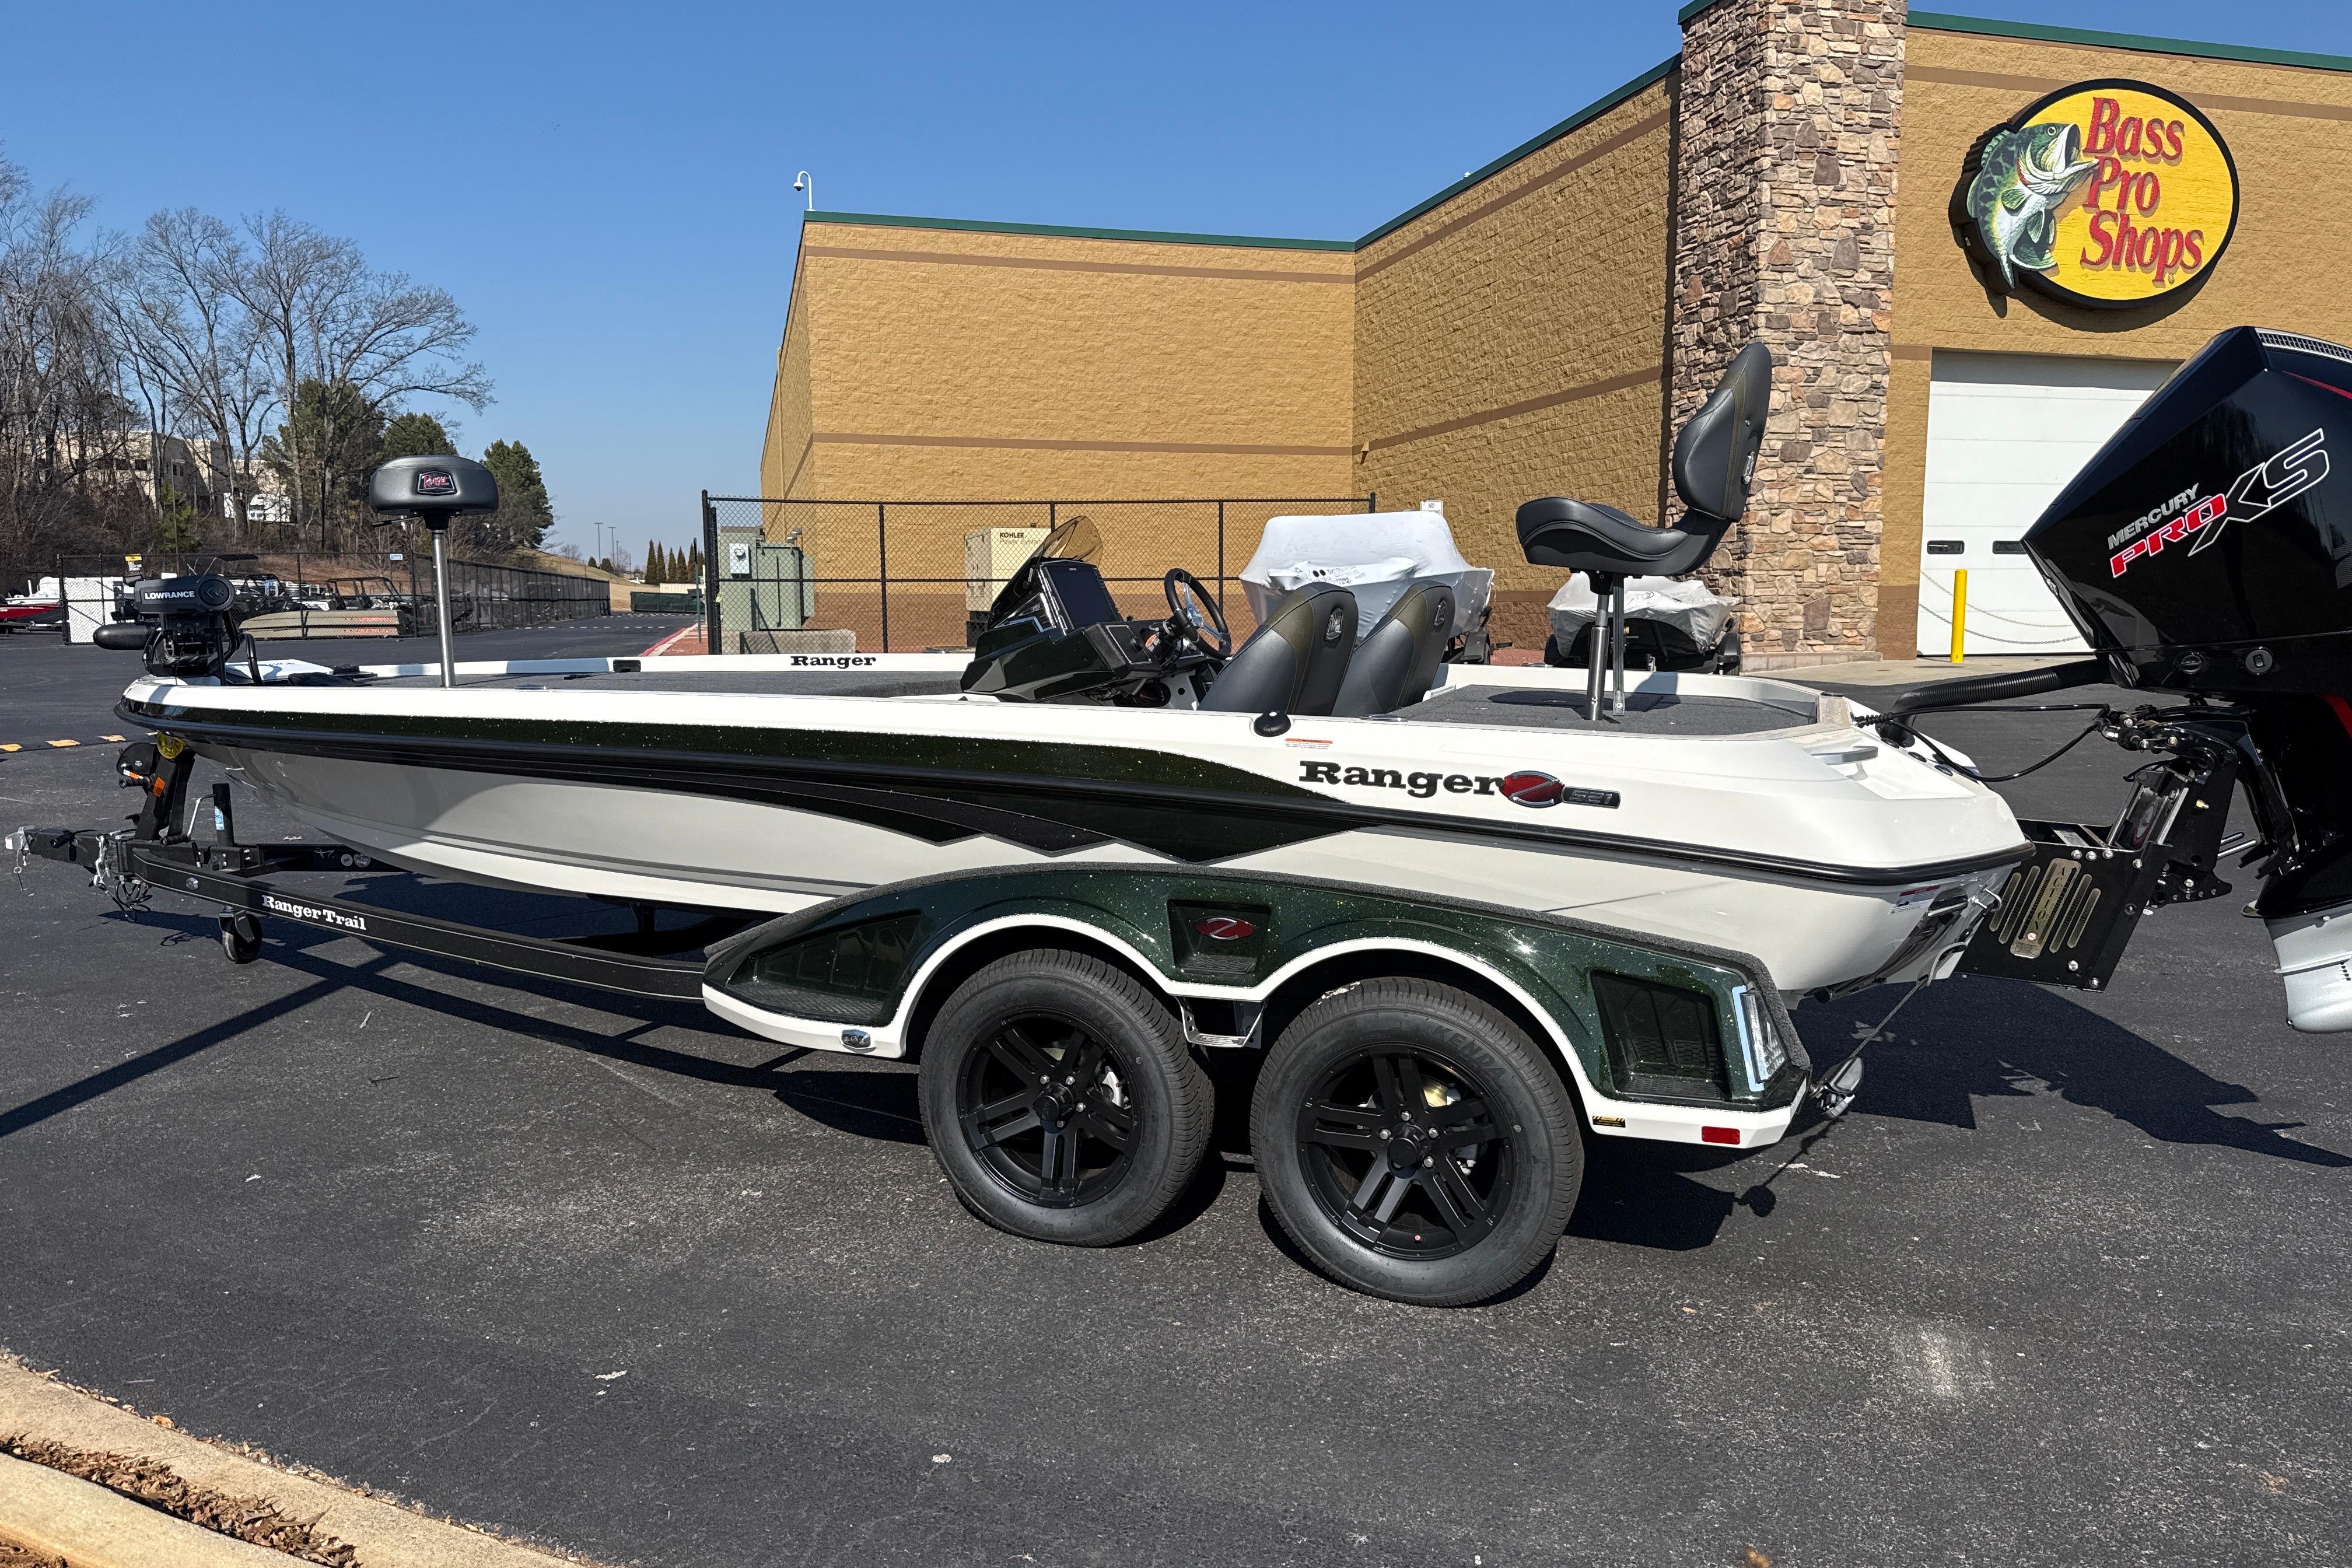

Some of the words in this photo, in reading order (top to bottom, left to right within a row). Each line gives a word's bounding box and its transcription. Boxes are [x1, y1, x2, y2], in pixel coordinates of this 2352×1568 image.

[2082, 96, 2185, 161] Bass
[2082, 155, 2160, 212] Pro
[2080, 210, 2204, 284] Shops
[2107, 482, 2199, 550] MERCURY
[2109, 492, 2228, 578] PRO
[144, 590, 196, 600] LOWRANCE
[790, 656, 877, 669] Ranger
[1298, 760, 1506, 798] Ranger
[261, 894, 321, 919] Ranger
[323, 909, 366, 930] Trail
[1431, 1025, 1507, 1080] KENDA
